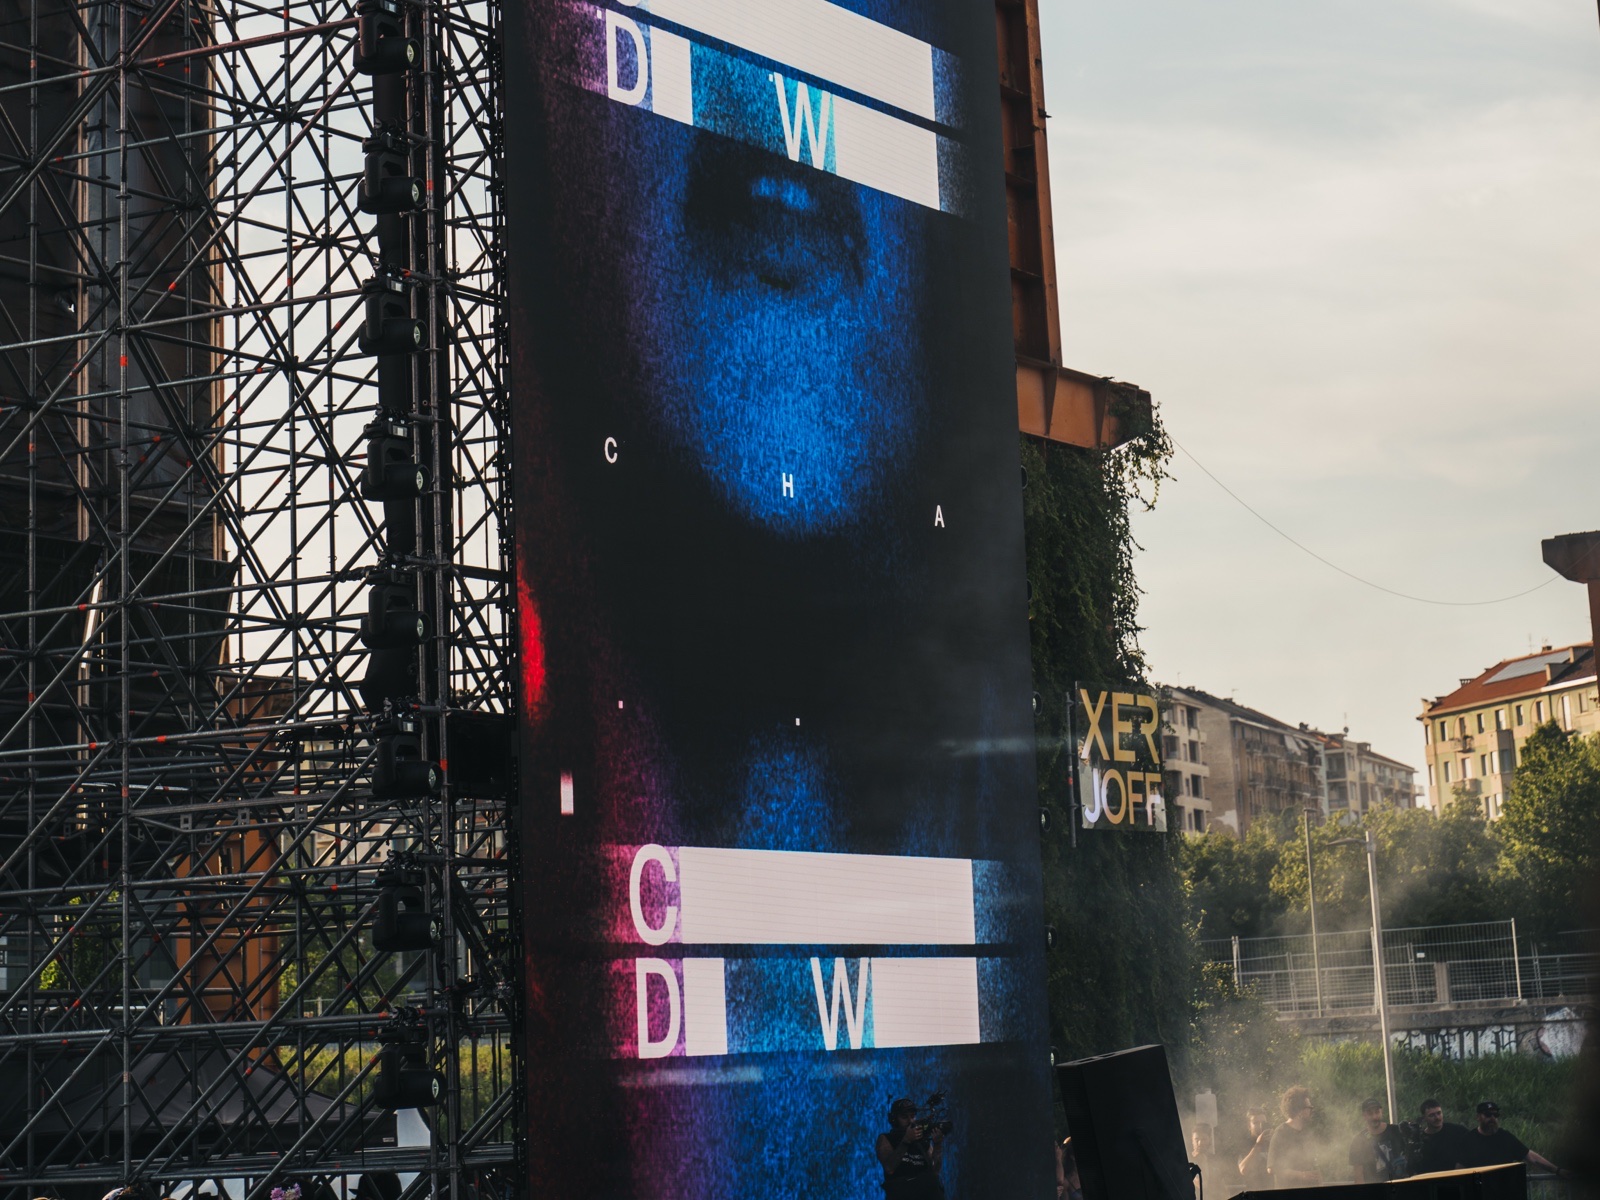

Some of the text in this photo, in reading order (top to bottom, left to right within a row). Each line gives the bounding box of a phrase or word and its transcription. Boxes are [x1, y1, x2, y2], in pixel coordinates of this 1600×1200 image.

[605, 8, 831, 171] D W
[604, 437, 945, 528] C H A
[1080, 688, 1160, 764] XER
[1084, 768, 1161, 825] JOFF
[629, 844, 677, 946] C
[635, 957, 870, 1059] D W
